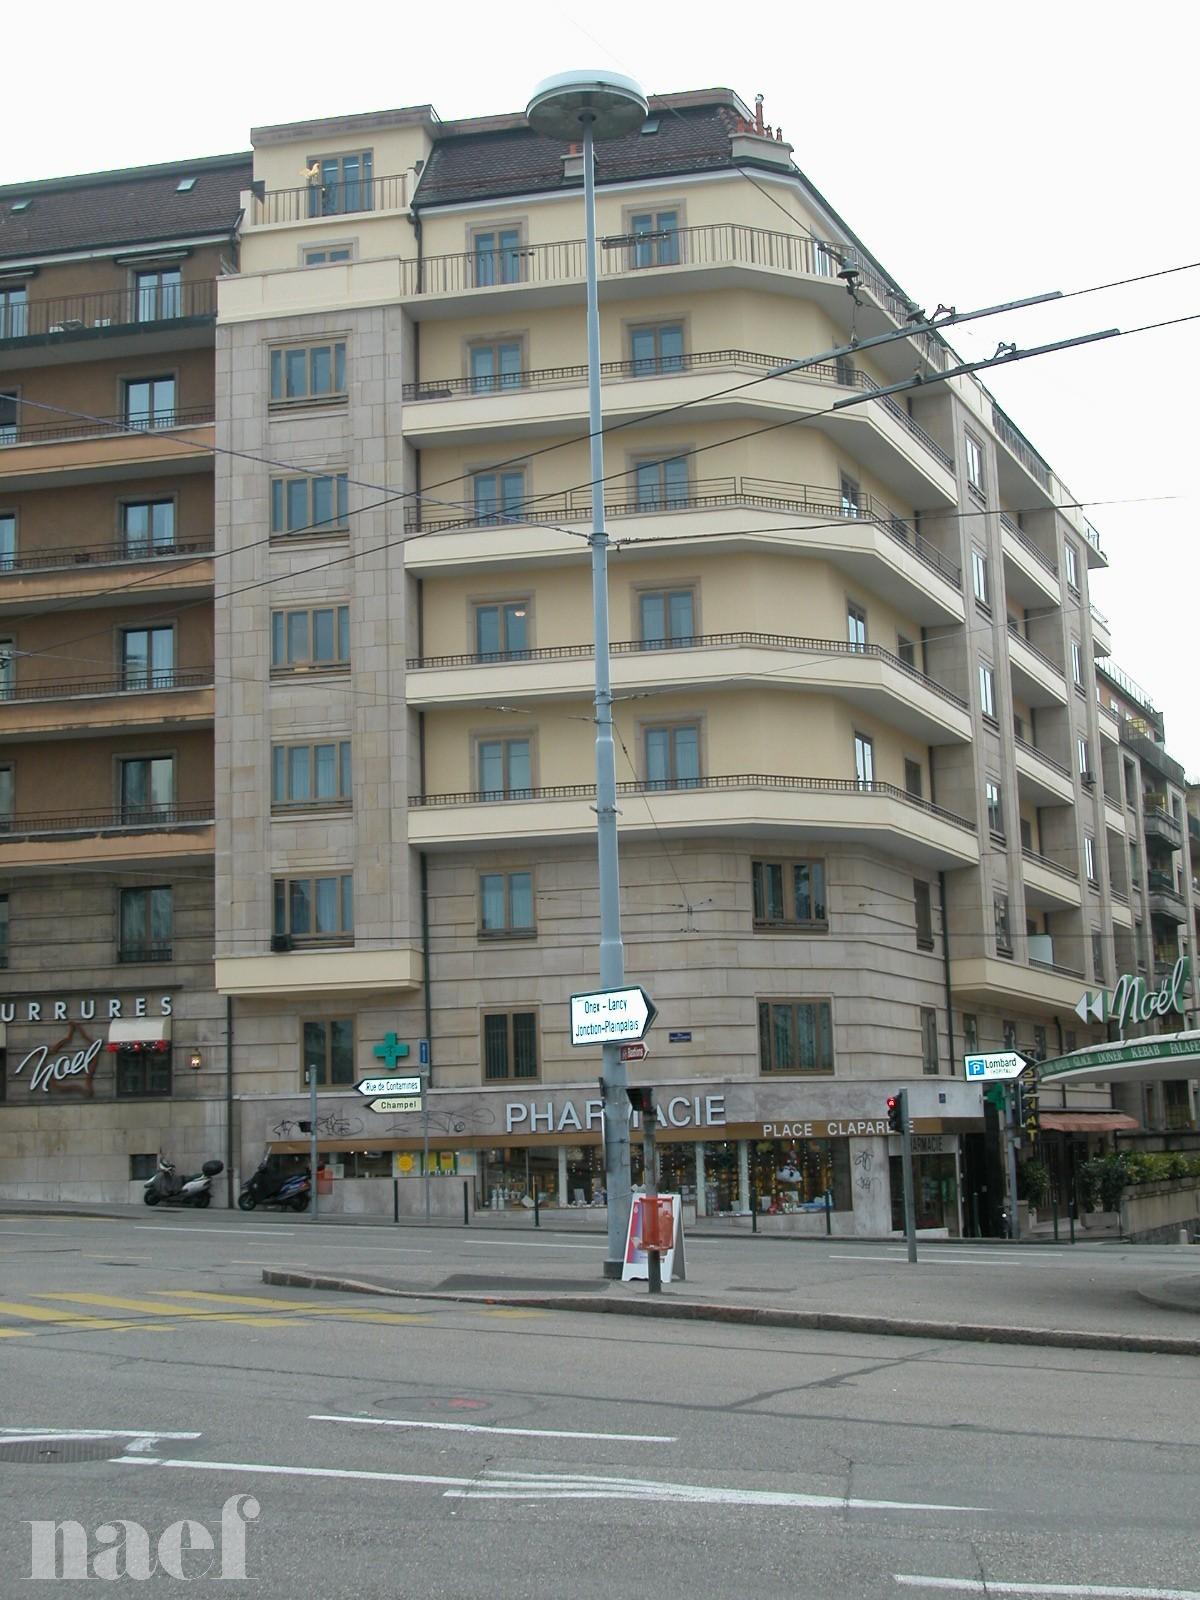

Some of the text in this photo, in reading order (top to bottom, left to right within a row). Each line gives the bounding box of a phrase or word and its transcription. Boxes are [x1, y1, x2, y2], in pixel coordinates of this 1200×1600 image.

[1, 996, 172, 1022] URRURES
[608, 998, 628, 1012] Lancy
[1130, 1044, 1161, 1059] KEBAB
[984, 1058, 1017, 1069] Lombard
[366, 1081, 418, 1091] Rue de Contamines
[381, 1101, 416, 1109] Champel
[506, 1095, 727, 1132] PHARCIE
[763, 1123, 813, 1137] PLACE
